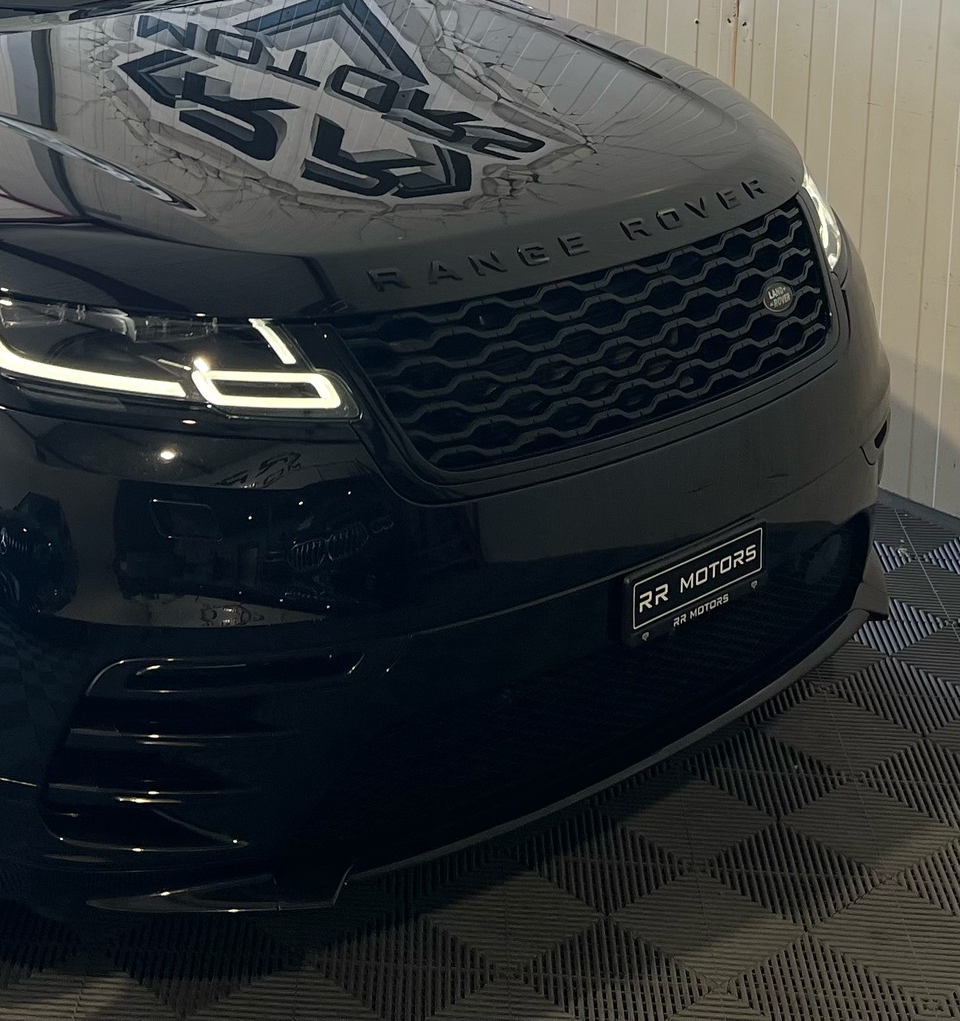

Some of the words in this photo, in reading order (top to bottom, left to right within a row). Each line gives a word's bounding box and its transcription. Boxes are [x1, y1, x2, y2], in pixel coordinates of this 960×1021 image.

[365, 231, 591, 293] RANGE
[619, 178, 767, 241] ROVER
[639, 582, 669, 613] RR
[679, 544, 757, 594] MOTORS
[673, 613, 687, 628] RR
[690, 593, 729, 620] MOTORS
